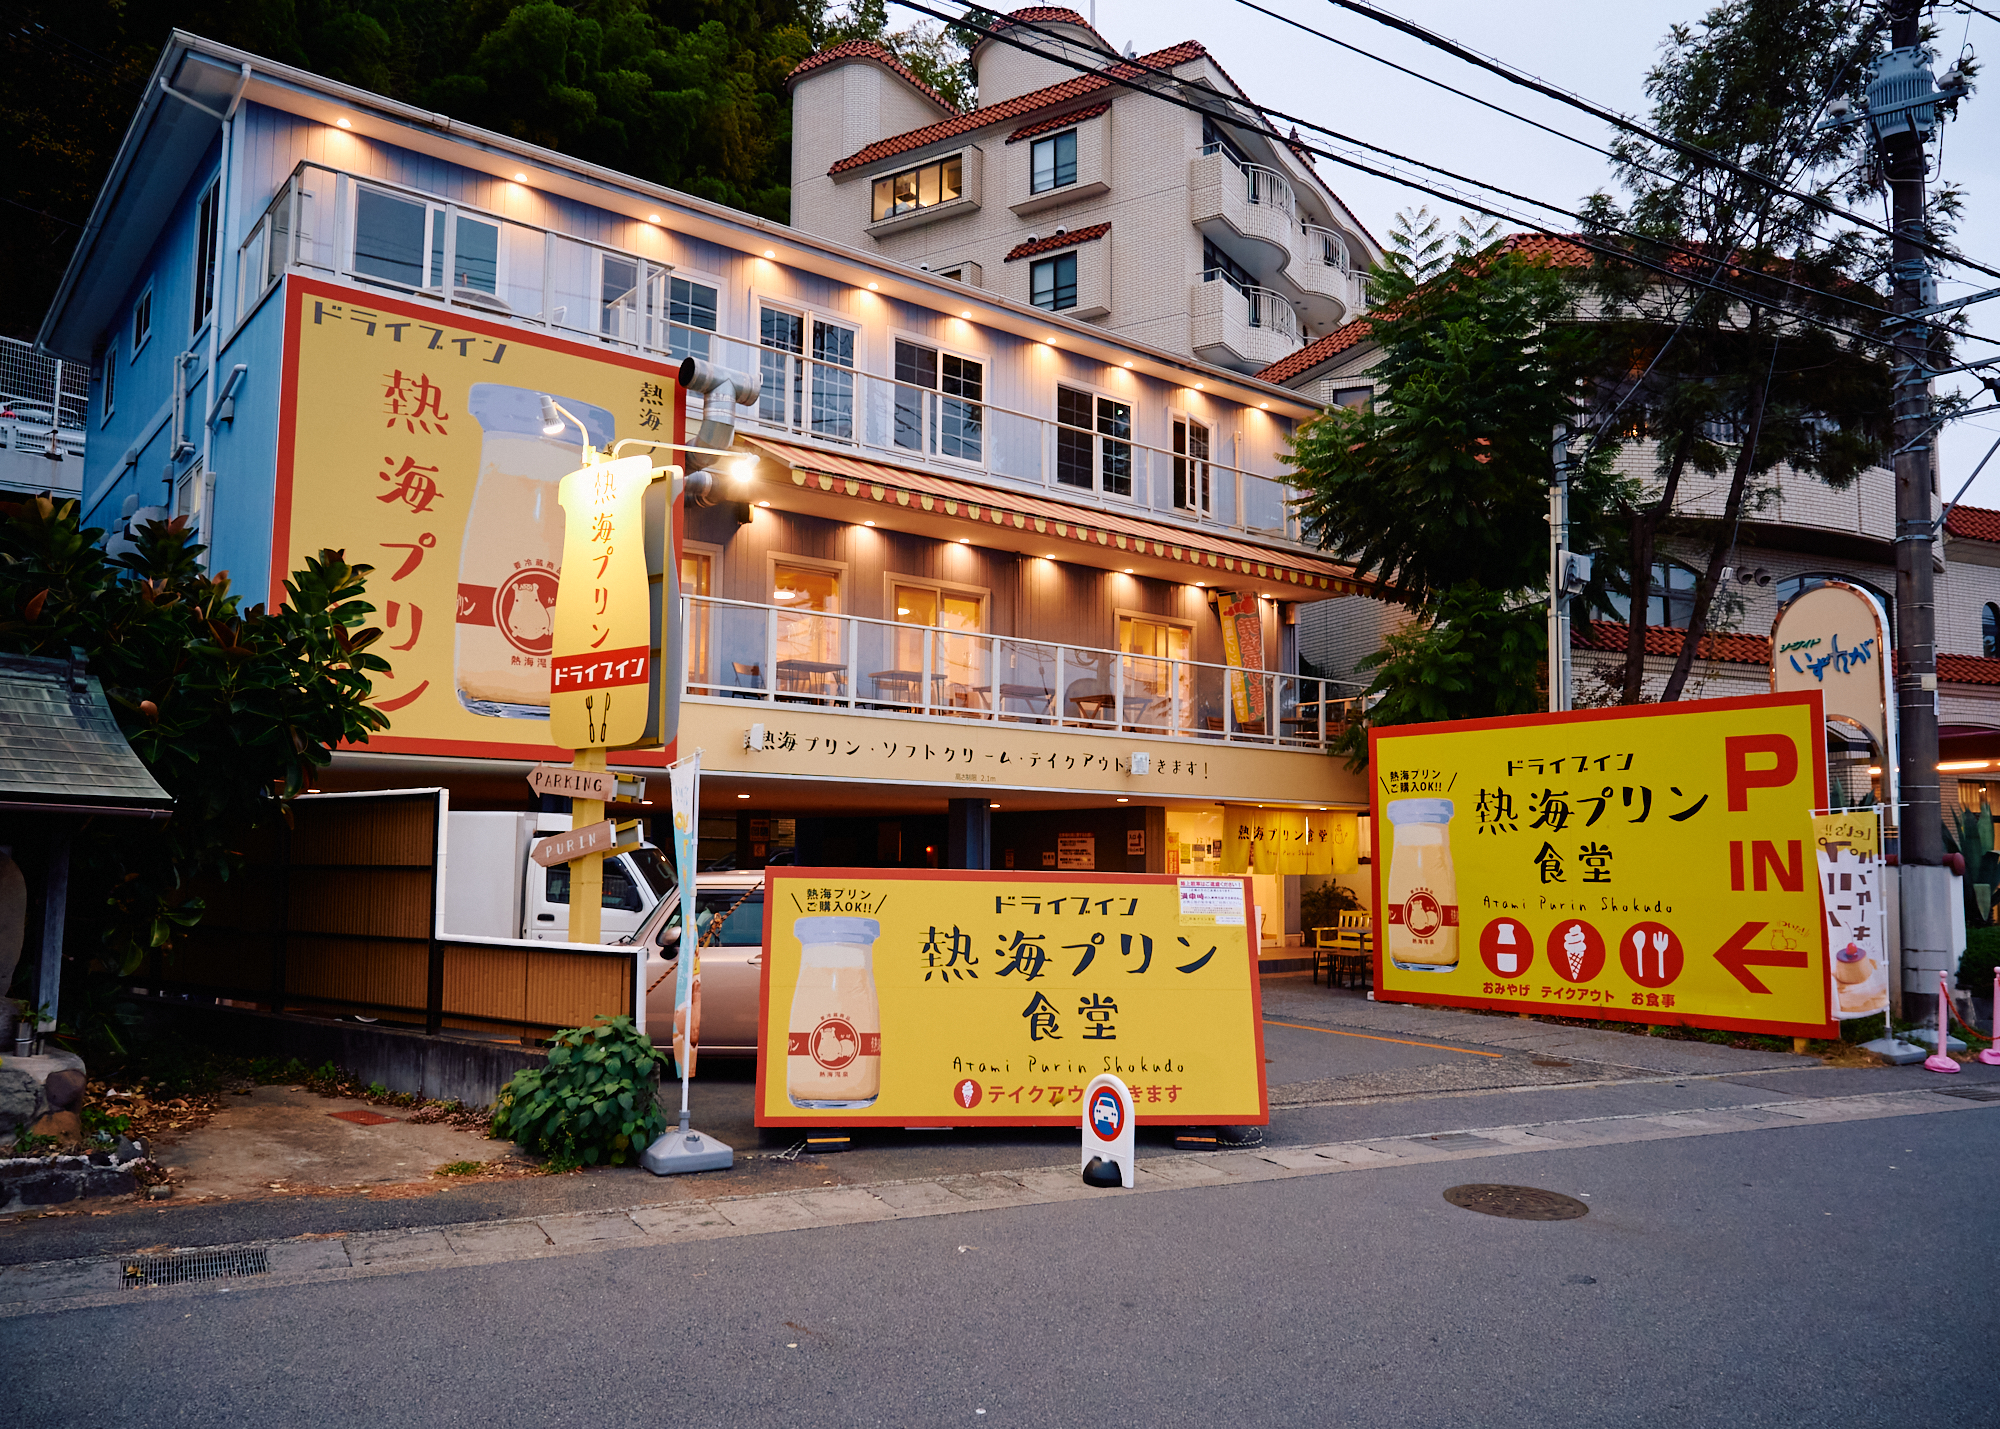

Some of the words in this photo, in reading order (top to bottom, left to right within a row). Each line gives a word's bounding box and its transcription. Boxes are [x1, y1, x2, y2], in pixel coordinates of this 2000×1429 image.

[314, 301, 507, 365] ドライブイン
[373, 369, 449, 712] 熱海プリン
[591, 470, 617, 649] 熱海プリン
[555, 658, 645, 686] ドライブイン
[1389, 769, 1441, 783] 熱海プリン
[1507, 752, 1634, 778] ドライブイン
[1725, 733, 1798, 812] P
[535, 772, 602, 792] PARKING
[1389, 780, 1443, 794] ご購入OK!!
[1474, 785, 1710, 836] 熱海プリン
[546, 832, 596, 858] PURIN
[1533, 841, 1614, 885] 食堂
[1730, 839, 1804, 893] IN
[806, 887, 872, 901] 熱海プリン
[995, 895, 1139, 916] ドライブイン
[1483, 895, 1526, 910] Atami
[1539, 895, 1587, 912] Purin
[1601, 897, 1672, 913] Shokudo
[806, 900, 873, 914] ご購入OK!!
[919, 923, 1218, 983] 熱海プリン
[1483, 981, 1531, 997] おみやげ
[1541, 986, 1615, 1003] テイクアウト
[1631, 992, 1676, 1008] お食事
[1021, 990, 1119, 1042] 食堂
[953, 1056, 1010, 1073] Atami
[1028, 1055, 1087, 1073] Purin
[1103, 1056, 1185, 1073] Shokudo
[988, 1084, 1183, 1104] テイクアウきます
